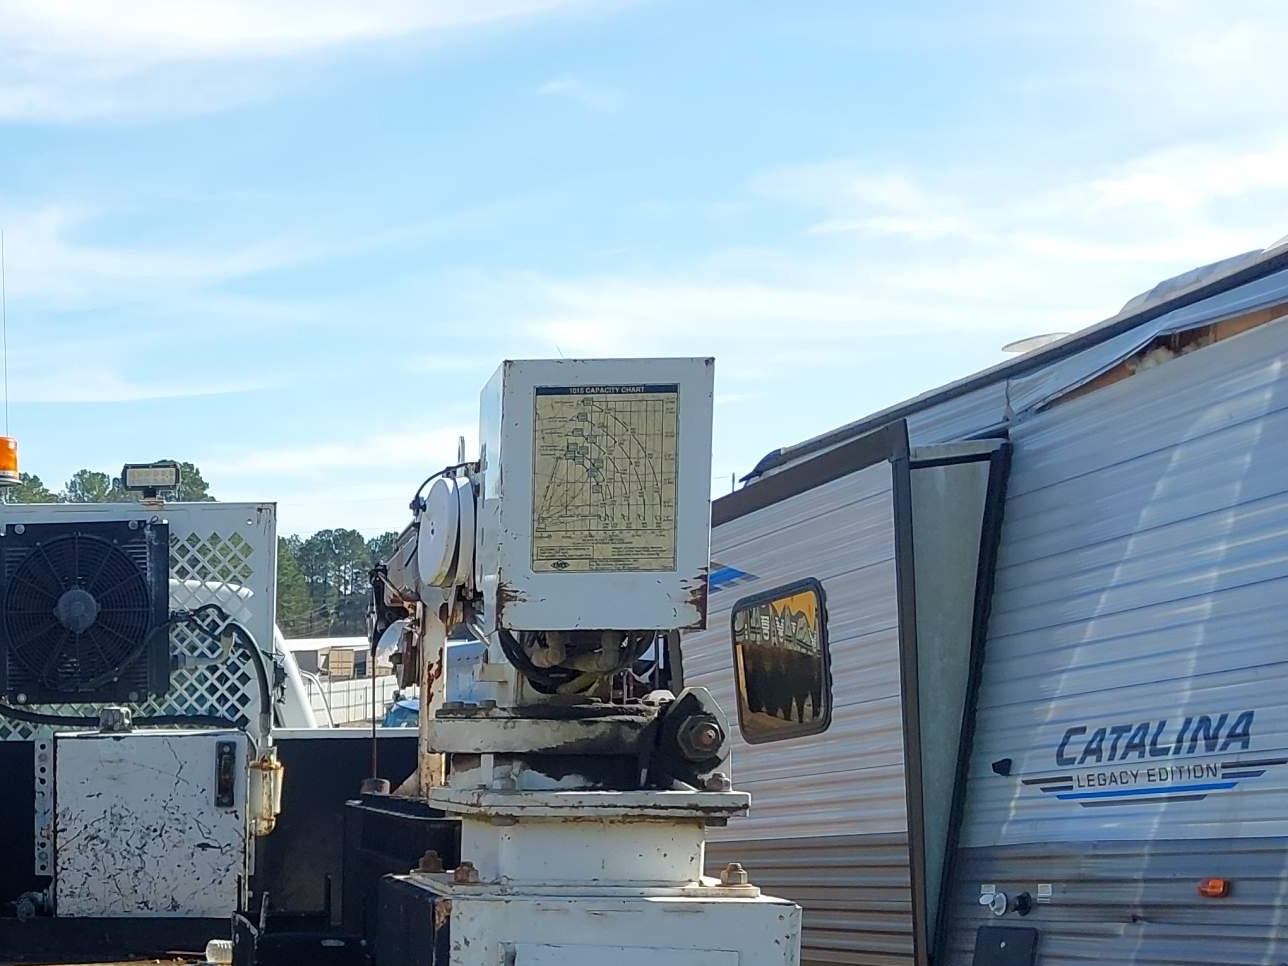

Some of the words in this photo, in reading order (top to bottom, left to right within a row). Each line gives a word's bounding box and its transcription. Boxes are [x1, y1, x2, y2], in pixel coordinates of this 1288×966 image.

[1055, 710, 1256, 766] CATALINA
[1076, 768, 1140, 788] LEGACY
[1147, 762, 1219, 783] EDITION
